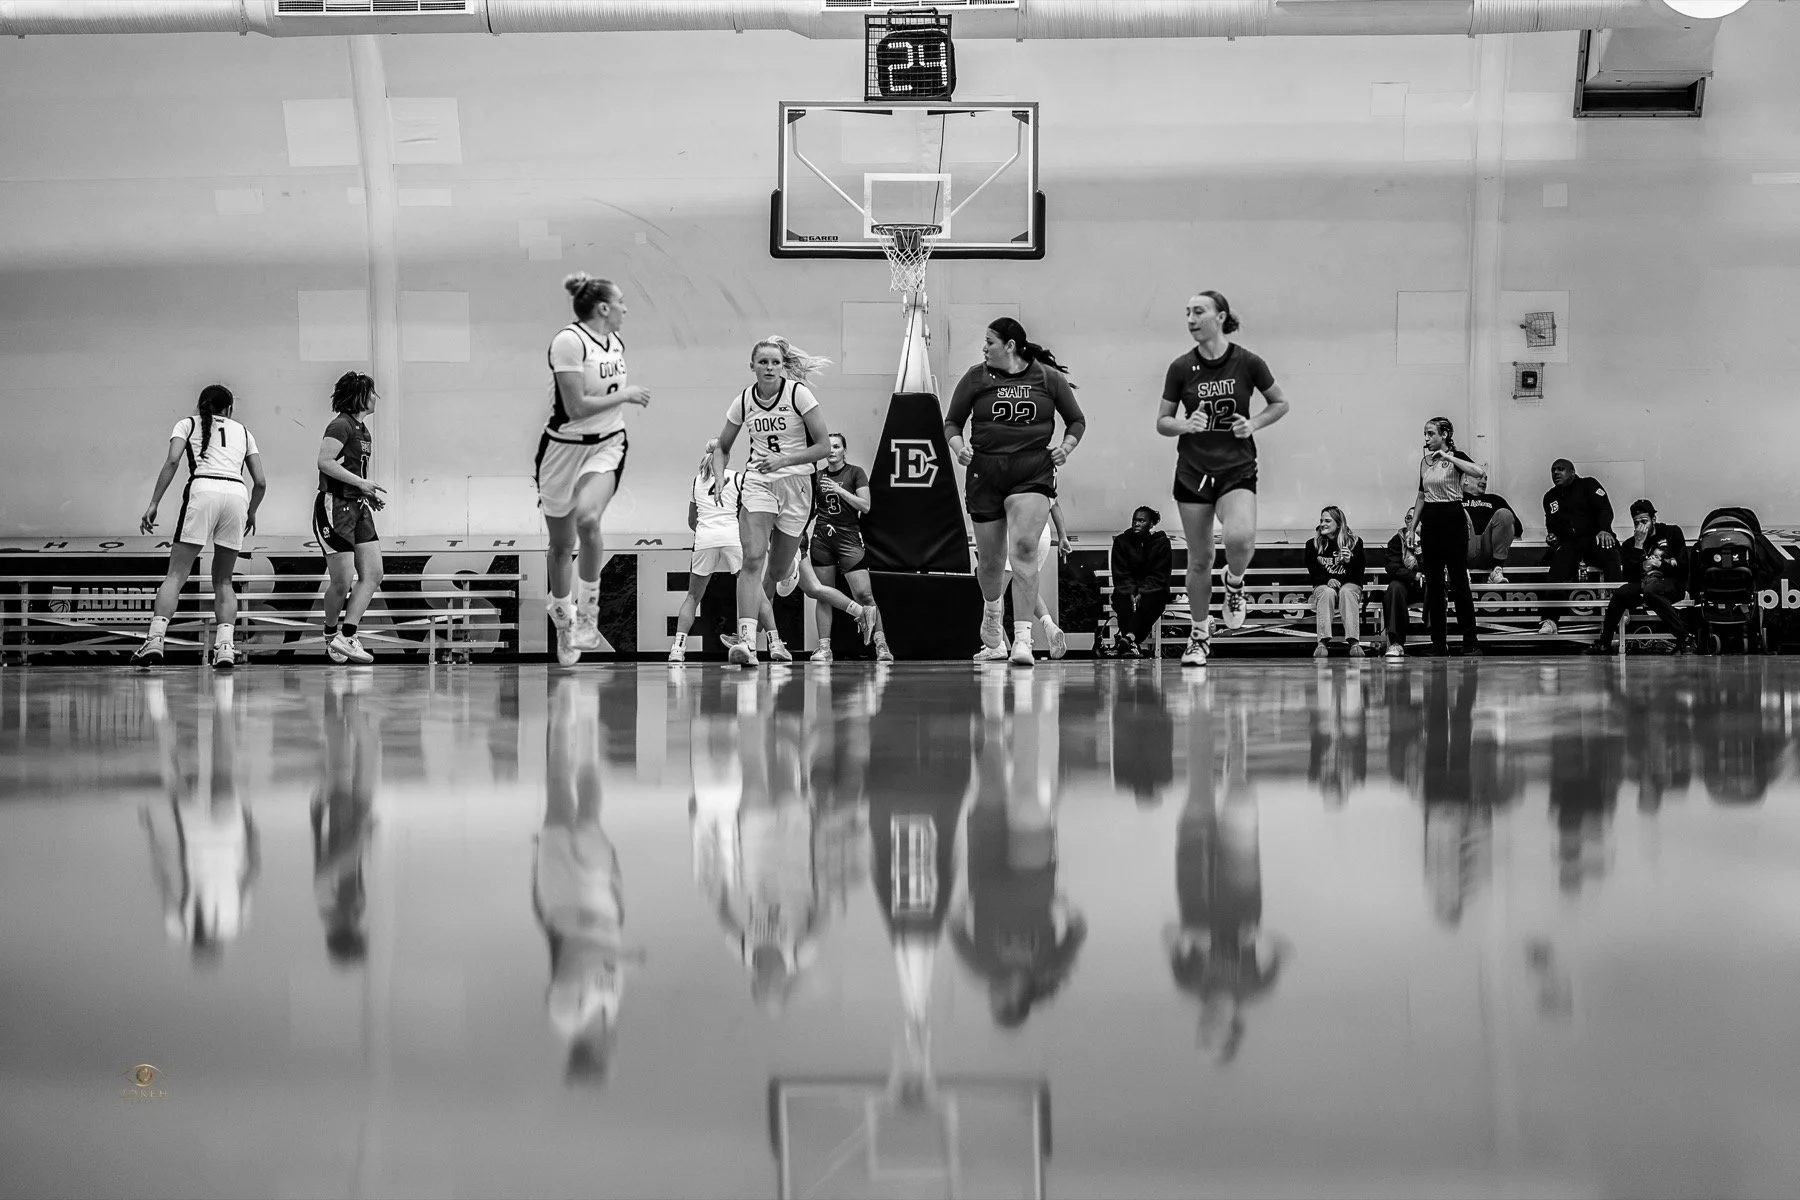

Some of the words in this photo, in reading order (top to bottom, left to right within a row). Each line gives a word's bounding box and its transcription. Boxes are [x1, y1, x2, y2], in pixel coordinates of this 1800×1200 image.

[888, 42, 947, 91] 24
[997, 385, 1031, 398] SAIT
[1198, 379, 1235, 398] SAIT
[991, 401, 1036, 423] 22
[1202, 398, 1236, 431] 12
[754, 417, 787, 432] OOKS
[218, 427, 226, 447] 1
[766, 435, 781, 453] 6
[890, 438, 939, 488] E
[825, 493, 842, 515] 3
[77, 587, 160, 610] ALBERT
